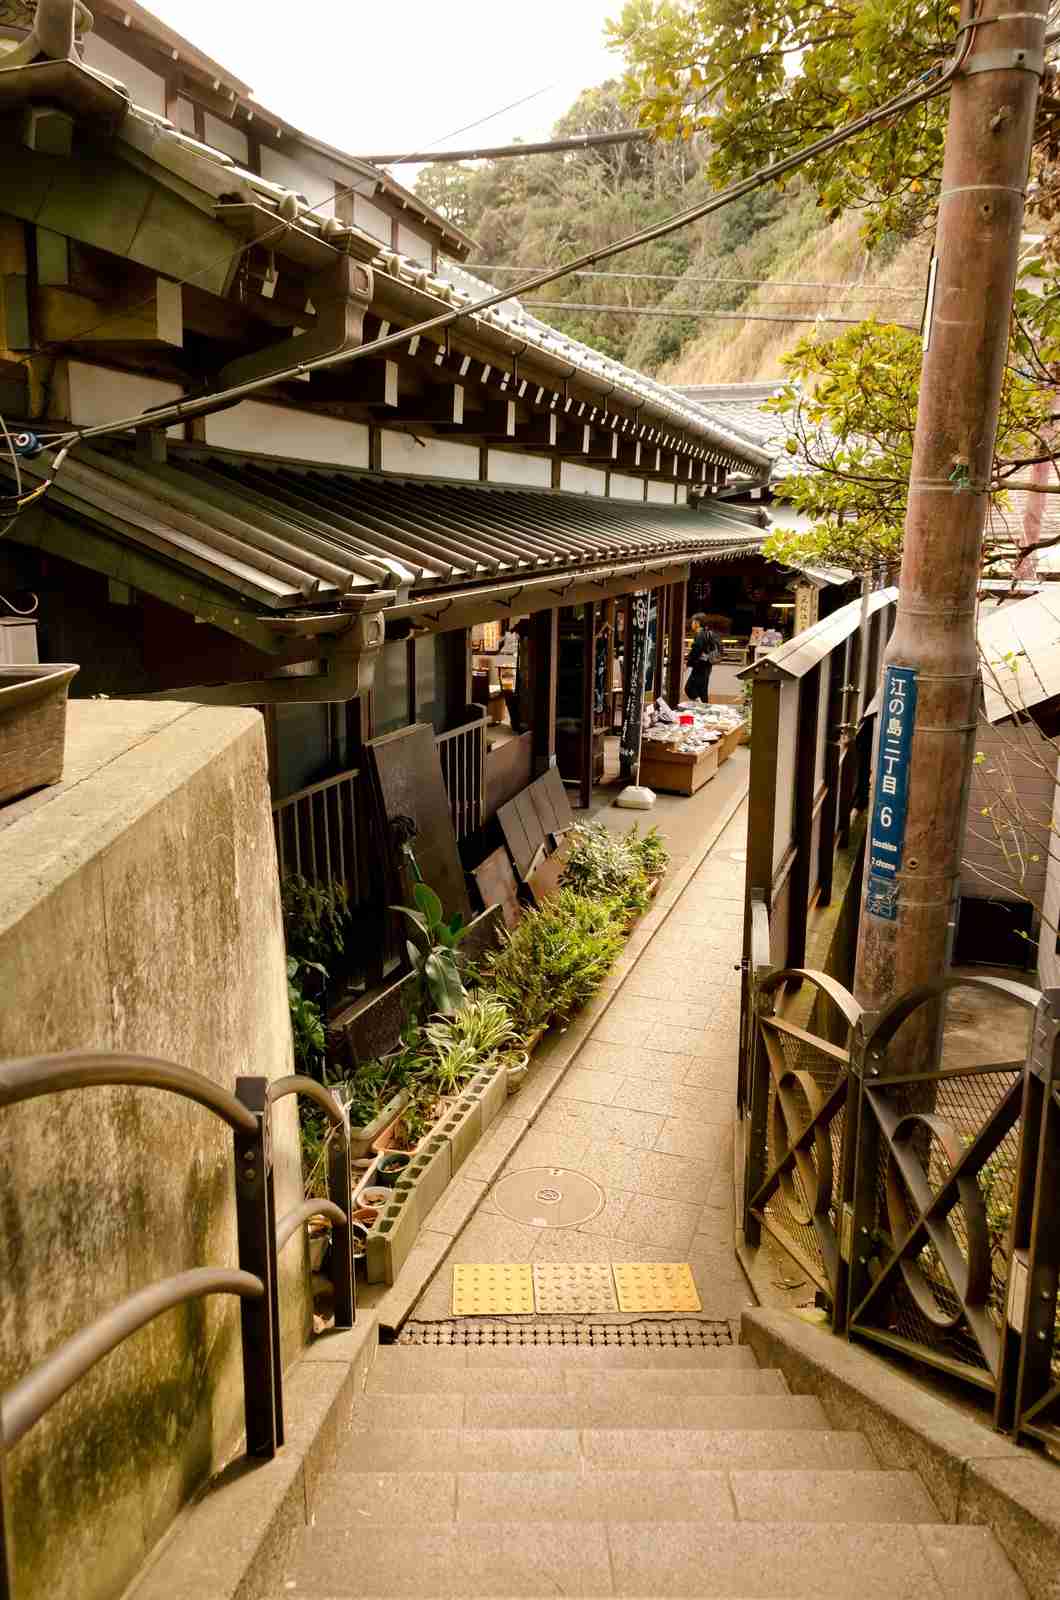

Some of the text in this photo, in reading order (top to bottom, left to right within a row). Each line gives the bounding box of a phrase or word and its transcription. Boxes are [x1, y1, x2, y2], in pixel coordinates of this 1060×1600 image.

[880, 677, 906, 828] 江の島二丁目 6
